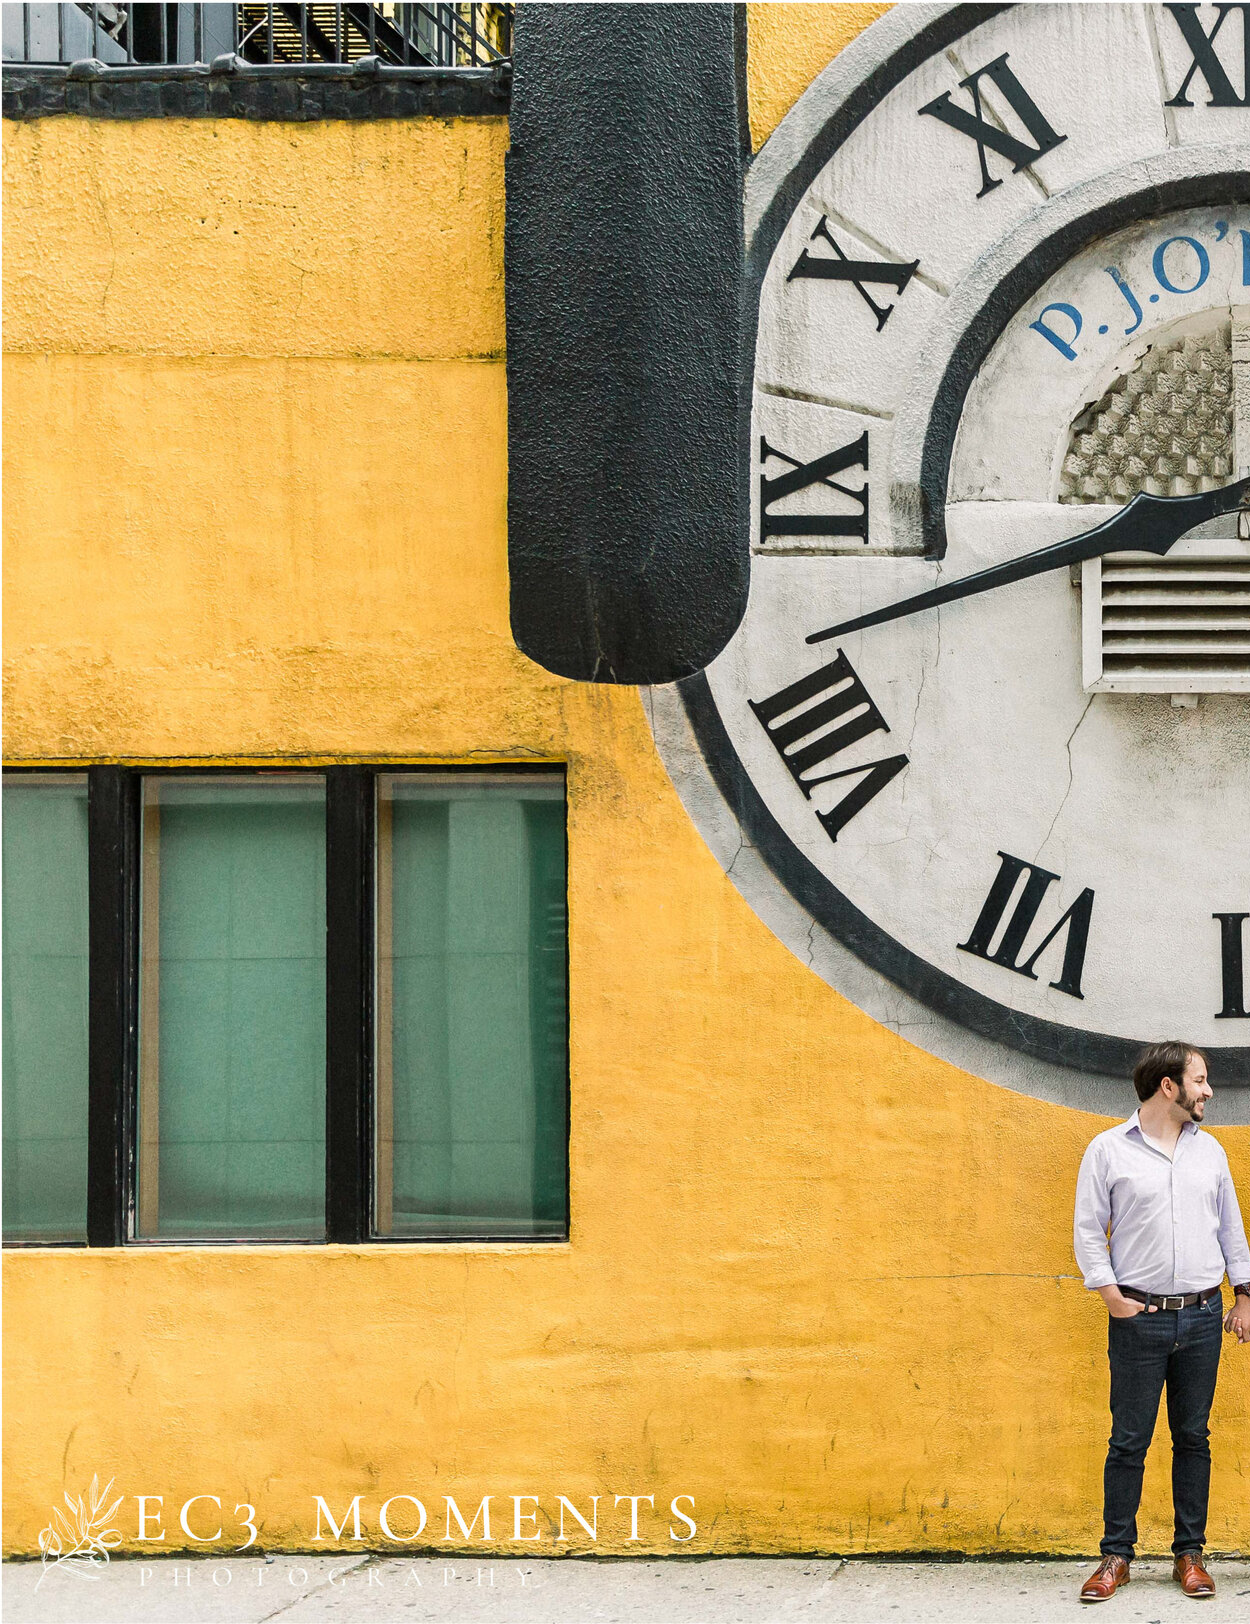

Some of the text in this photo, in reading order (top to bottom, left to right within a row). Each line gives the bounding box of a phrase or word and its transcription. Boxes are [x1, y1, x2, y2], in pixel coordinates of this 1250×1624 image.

[918, 52, 1068, 199] XI
[786, 215, 920, 332] X
[760, 431, 869, 544] IX
[747, 648, 910, 843] VIII
[956, 851, 1095, 1000] VII
